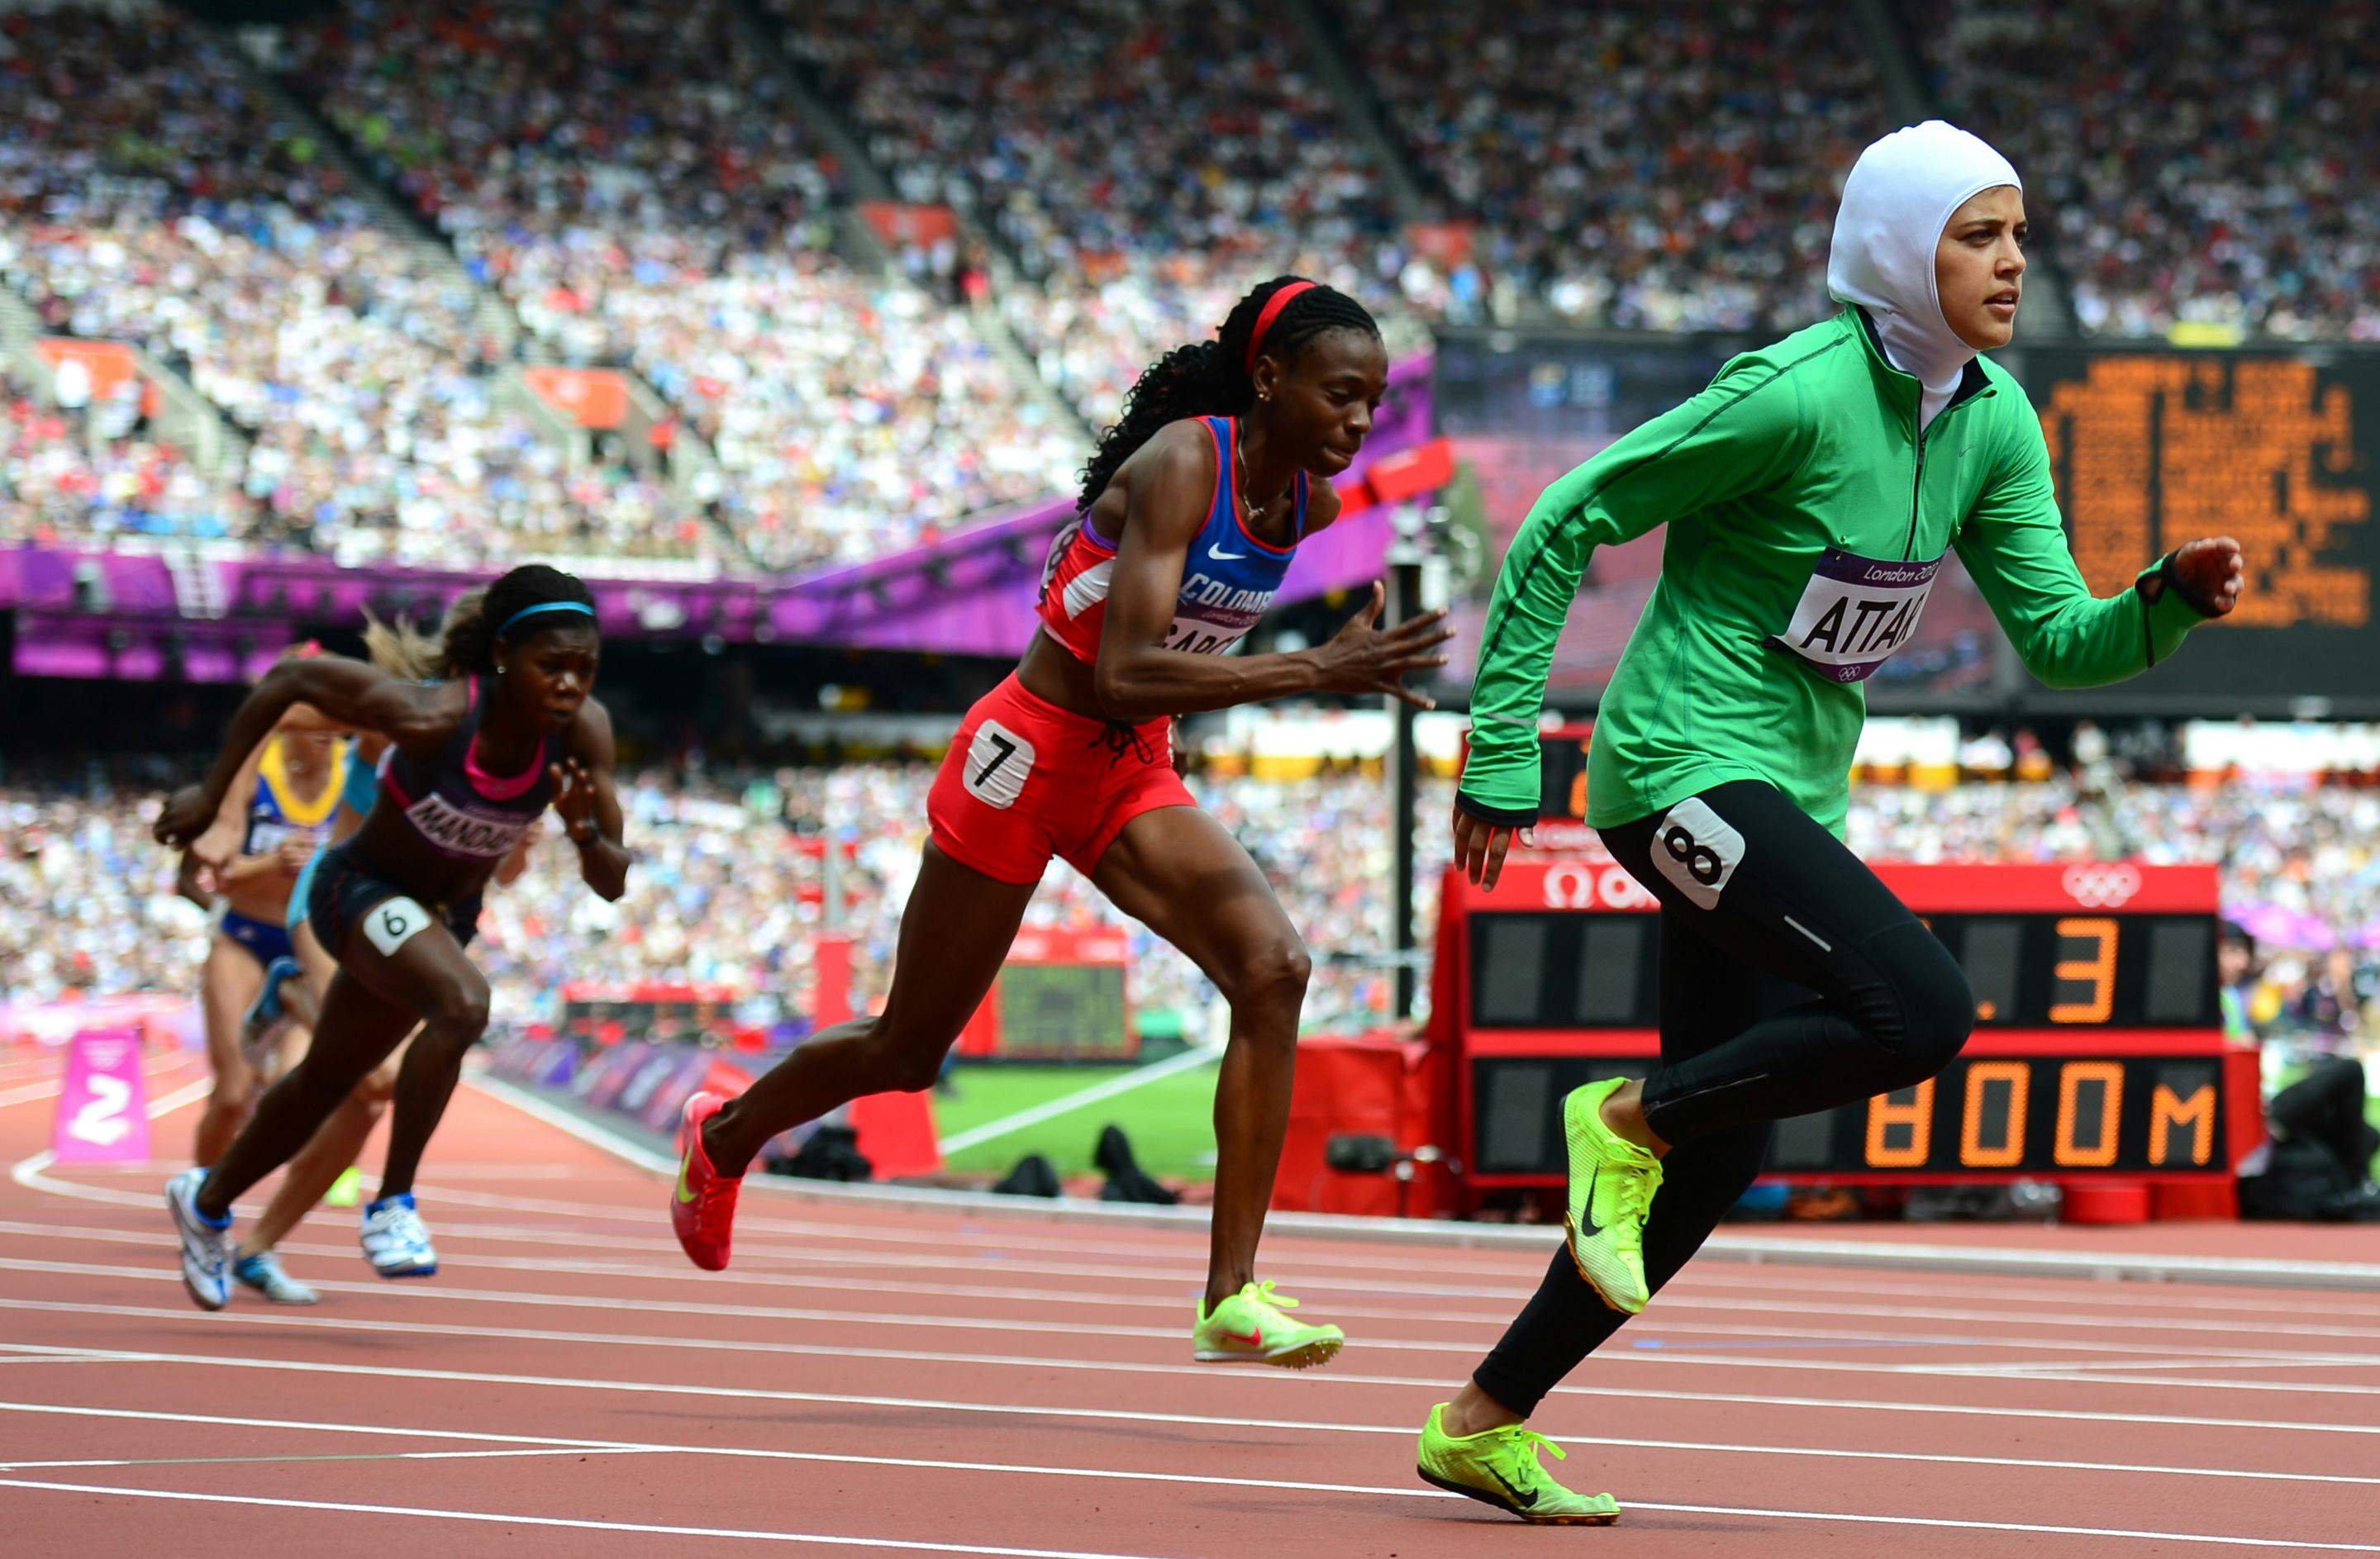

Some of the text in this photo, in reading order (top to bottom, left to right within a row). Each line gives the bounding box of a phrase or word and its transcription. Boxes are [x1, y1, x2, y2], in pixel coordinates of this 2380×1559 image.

[1864, 565, 1915, 582] London
[1799, 592, 1925, 654] ATTAR
[973, 732, 1016, 787] 7
[1664, 826, 1722, 886] 8
[383, 910, 407, 937] 6
[66, 1072, 134, 1147] 2
[1865, 1061, 2217, 1167] 800M
